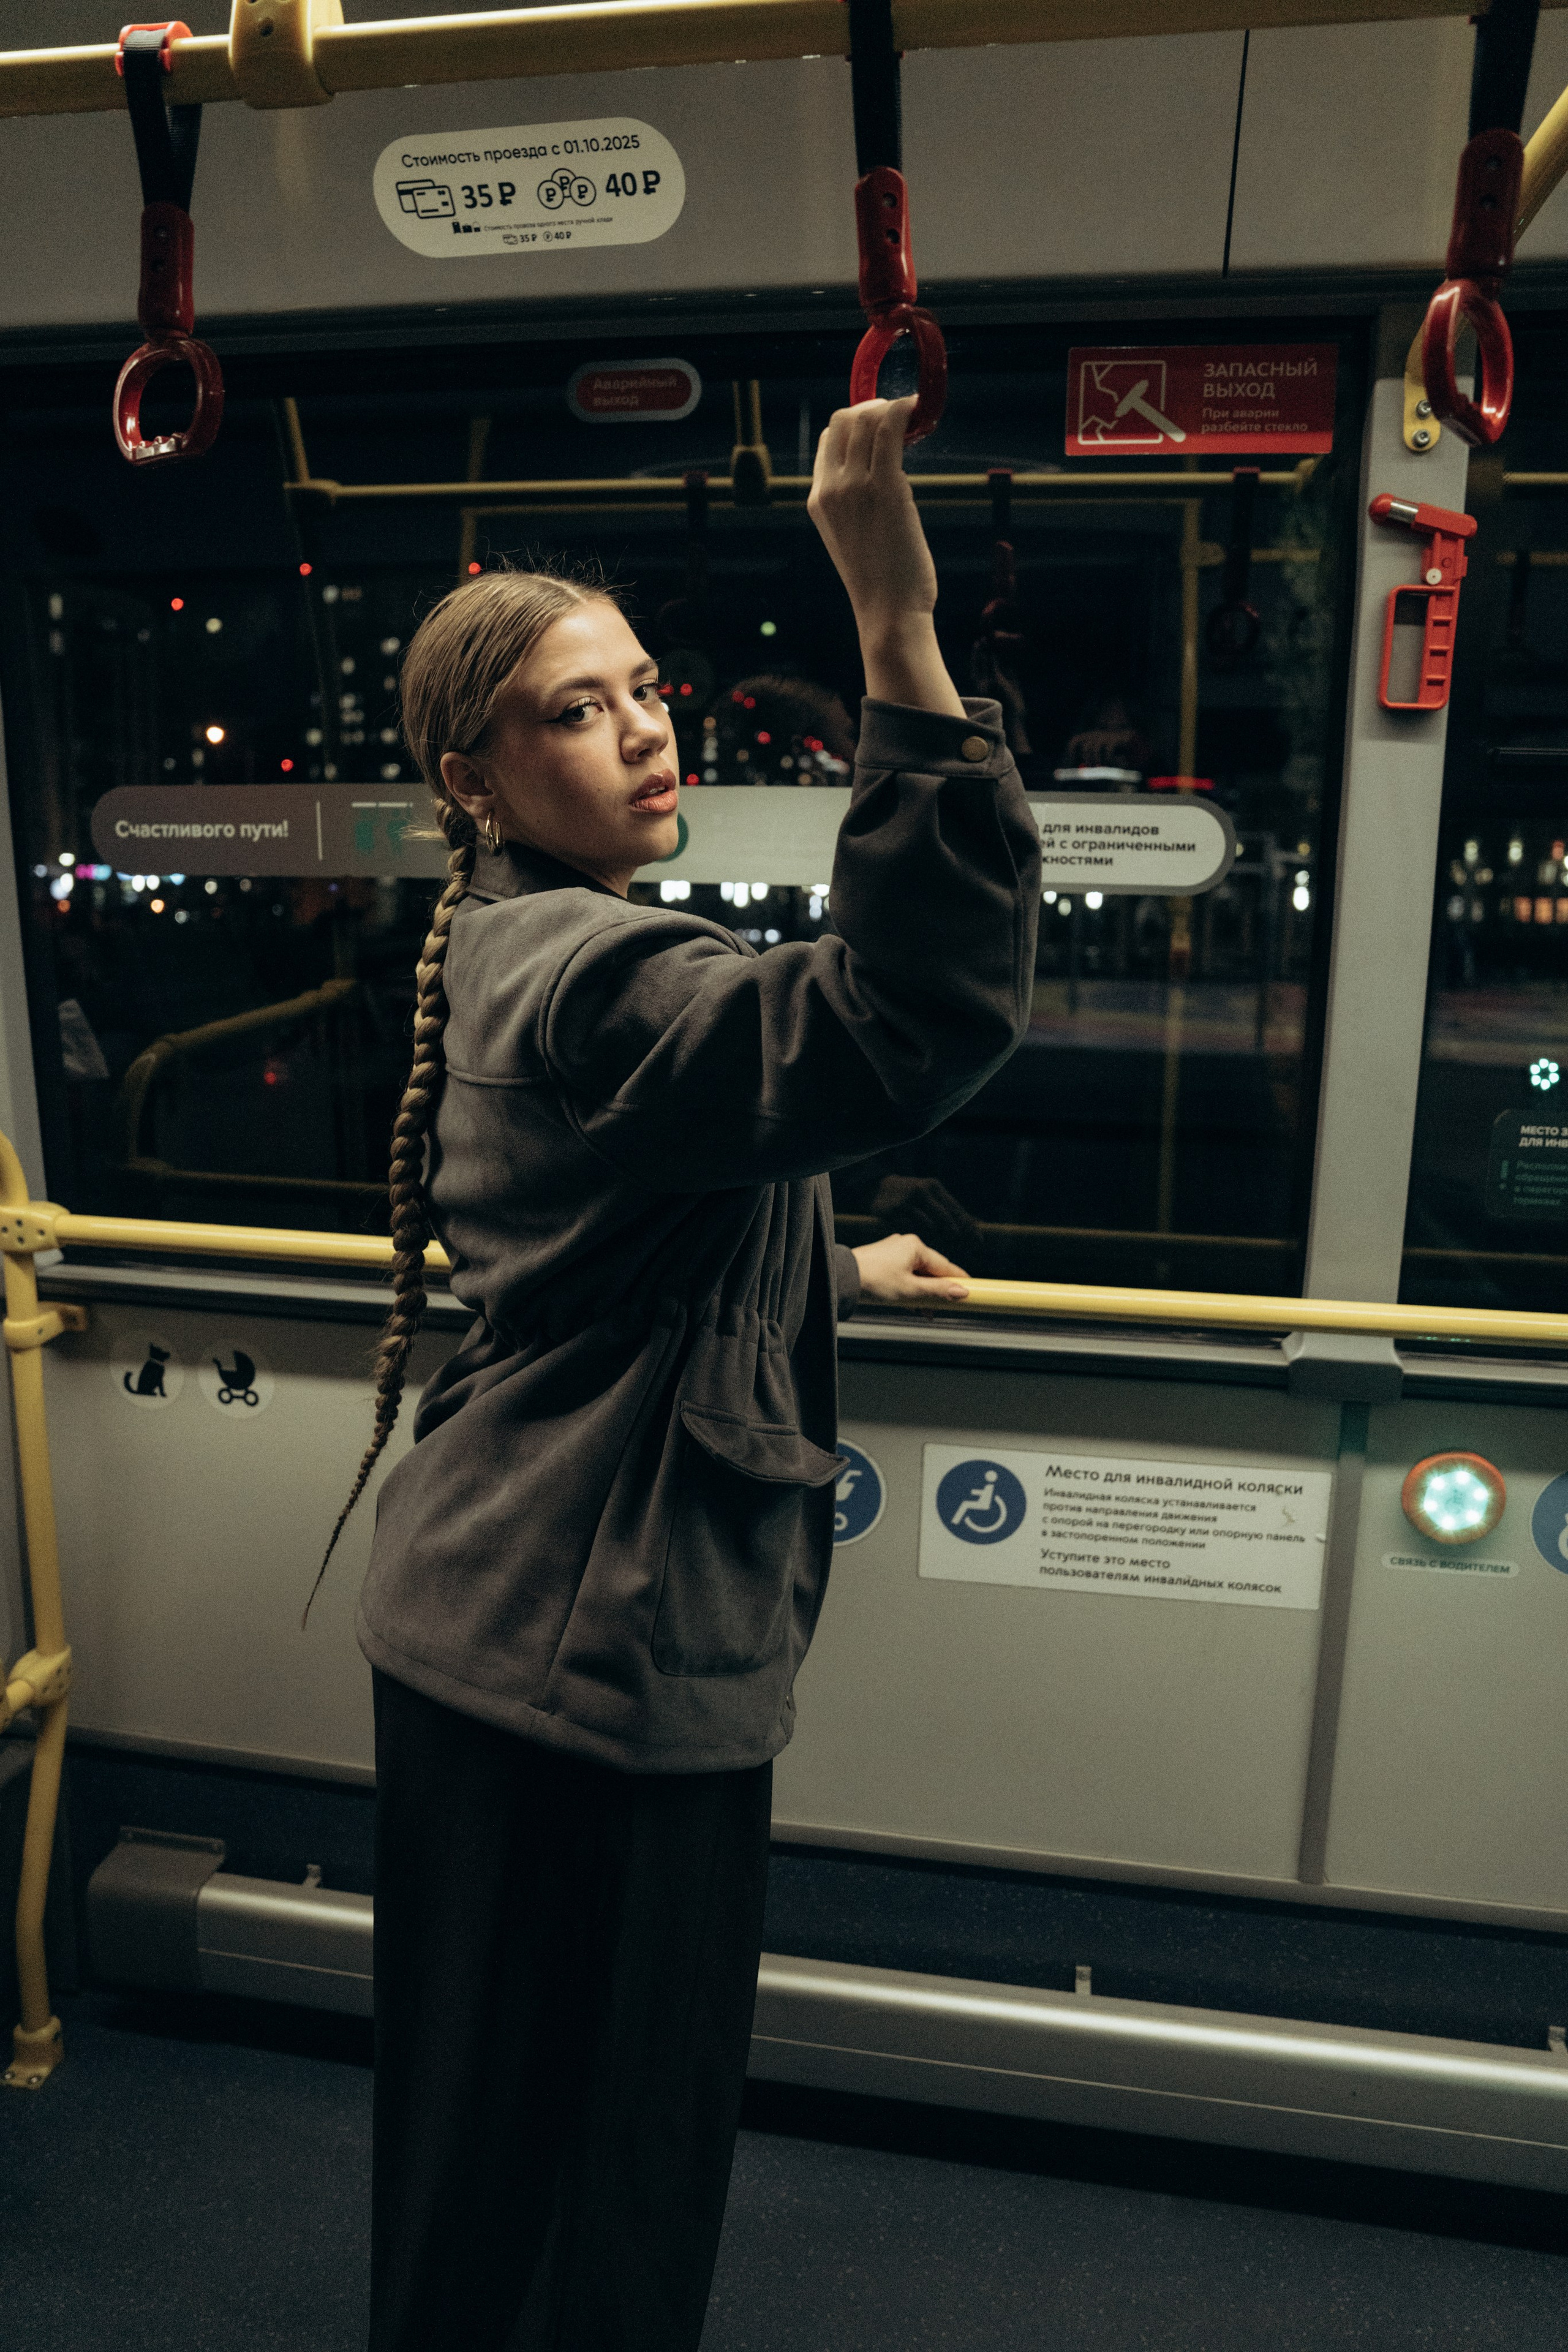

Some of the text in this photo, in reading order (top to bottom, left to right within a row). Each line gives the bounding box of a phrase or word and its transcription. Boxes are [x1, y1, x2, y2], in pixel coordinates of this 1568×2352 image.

[402, 134, 640, 168] Стоимость проезда с 01.10.2025
[461, 184, 493, 209] 35
[606, 172, 637, 197] 40
[519, 233, 530, 243] 35
[1203, 357, 1318, 377] ЗАПАСНЫЙ
[1203, 382, 1276, 400] ВЫХОД
[1202, 407, 1280, 421] При аварии
[1200, 421, 1308, 435] разбейте стекло
[115, 819, 289, 842] Счастливого пути!
[1042, 824, 1159, 836] для инвалидов
[1060, 840, 1068, 849] с
[1072, 840, 1196, 854] ограниченными
[1520, 1125, 1559, 1136] МЕСТО
[1518, 1137, 1544, 1148] ДЛЯ
[1045, 1464, 1303, 1495] Место для инвалидной коляски
[1044, 1487, 1256, 1512] Инвалидная коляска устанавливается
[1043, 1502, 1218, 1523] против направления движения
[1050, 1516, 1093, 1527] опорой
[1112, 1521, 1186, 1536] перегородку
[1189, 1528, 1210, 1536] или
[1212, 1529, 1263, 1541] опорную
[1266, 1532, 1305, 1543] панель
[1051, 1530, 1139, 1544] застопоренном
[1142, 1537, 1205, 1549] положении
[1040, 1548, 1170, 1569] Уступите это место
[1390, 1556, 1427, 1567] СВЯЗЬ
[1439, 1561, 1510, 1573] ВОДИТЕЛЕМ
[1039, 1566, 1282, 1593] пользователям инвалидных колясок
